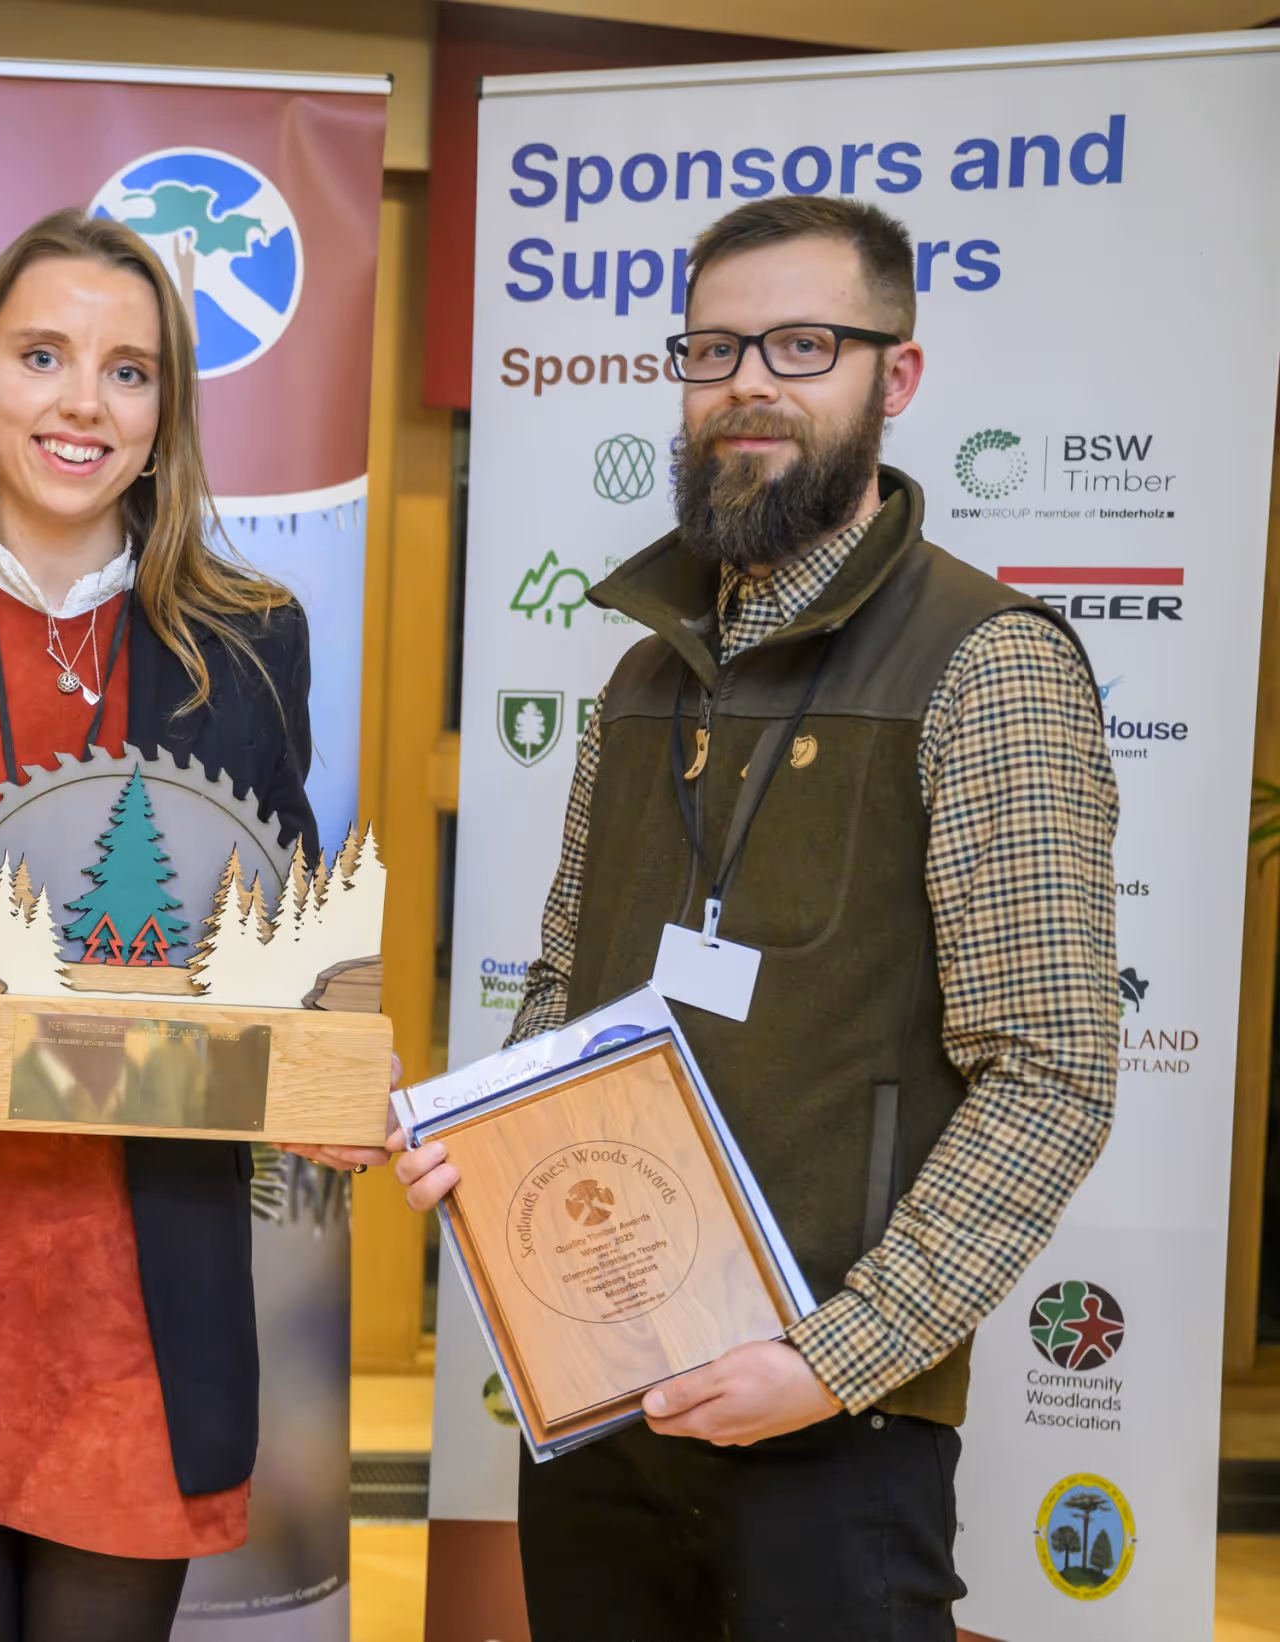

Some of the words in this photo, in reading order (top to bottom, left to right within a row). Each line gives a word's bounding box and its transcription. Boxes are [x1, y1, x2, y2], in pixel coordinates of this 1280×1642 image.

[509, 141, 923, 223] Sponsors
[949, 114, 1127, 191] and
[1063, 435, 1153, 462] BSW
[1063, 468, 1176, 492] Timber
[951, 508, 1030, 519] BSWGROUP
[1035, 508, 1081, 519] member
[1085, 508, 1096, 519] of
[1100, 507, 1165, 519] binderholz
[531, 1156, 569, 1191] Finest
[572, 1149, 628, 1166] Woods
[632, 1157, 677, 1206] Awards
[619, 1213, 651, 1230] Awards
[1027, 1369, 1123, 1394] Community
[1027, 1389, 1122, 1412] Woodlands
[1025, 1410, 1121, 1432] Association
